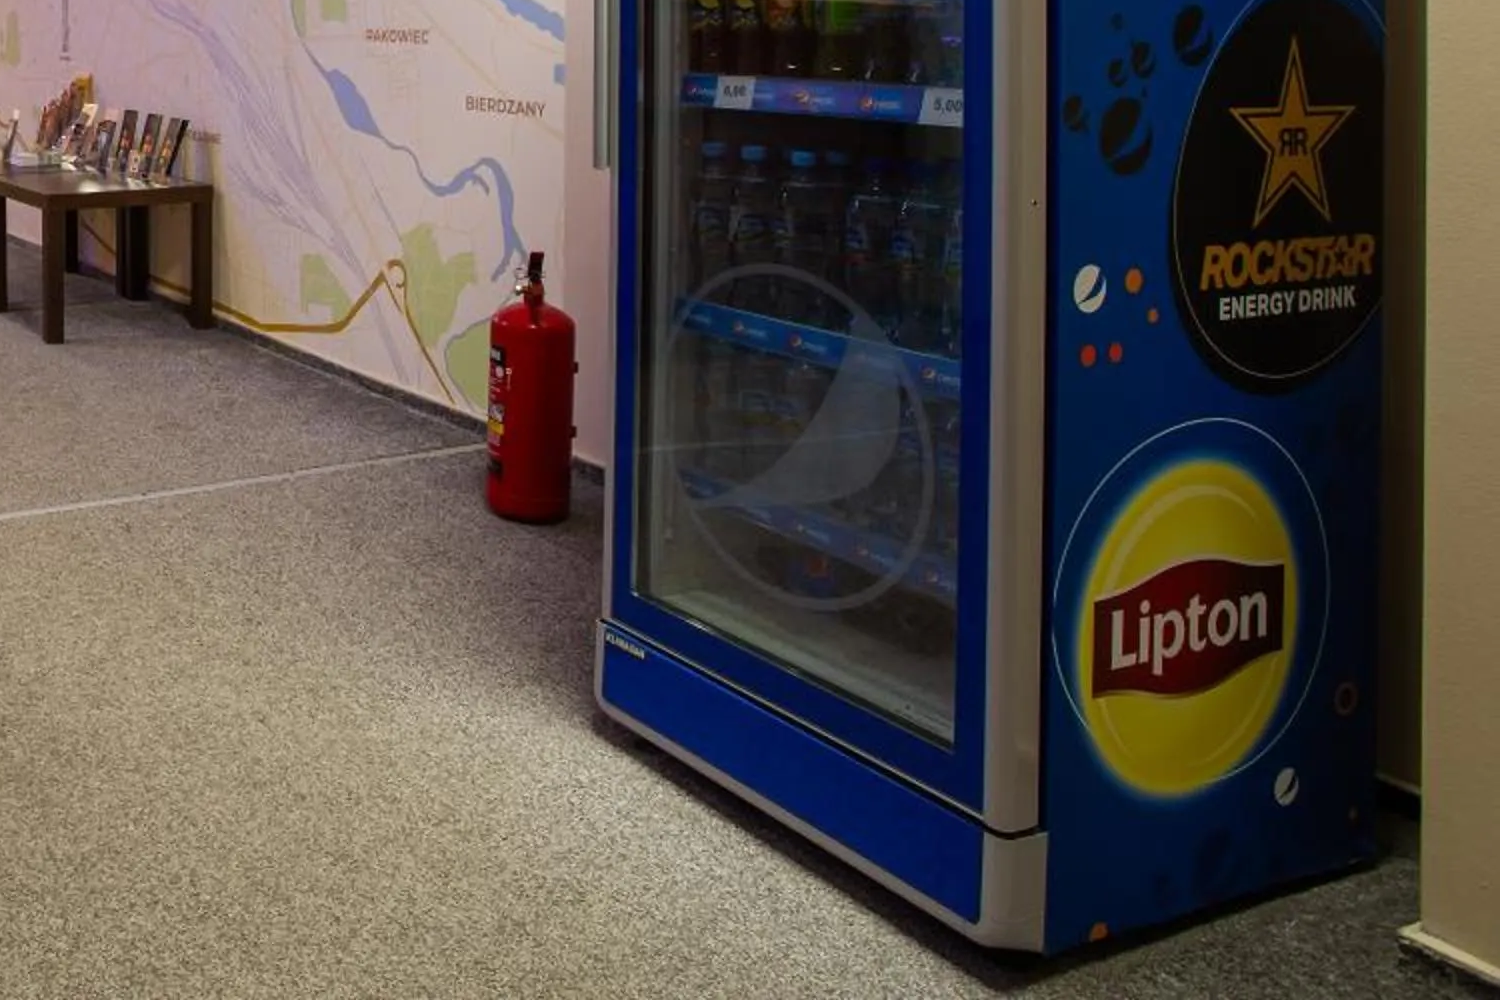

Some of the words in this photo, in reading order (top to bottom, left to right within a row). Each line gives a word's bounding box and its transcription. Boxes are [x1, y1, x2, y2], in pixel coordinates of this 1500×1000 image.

[365, 28, 430, 45] RAKOWIEC
[465, 96, 546, 118] BIERDZANY
[1200, 233, 1375, 291] ROCKSTAR
[1218, 290, 1293, 321] ENERGY
[1297, 285, 1357, 312] DRINK
[1110, 591, 1268, 677] Lipton
